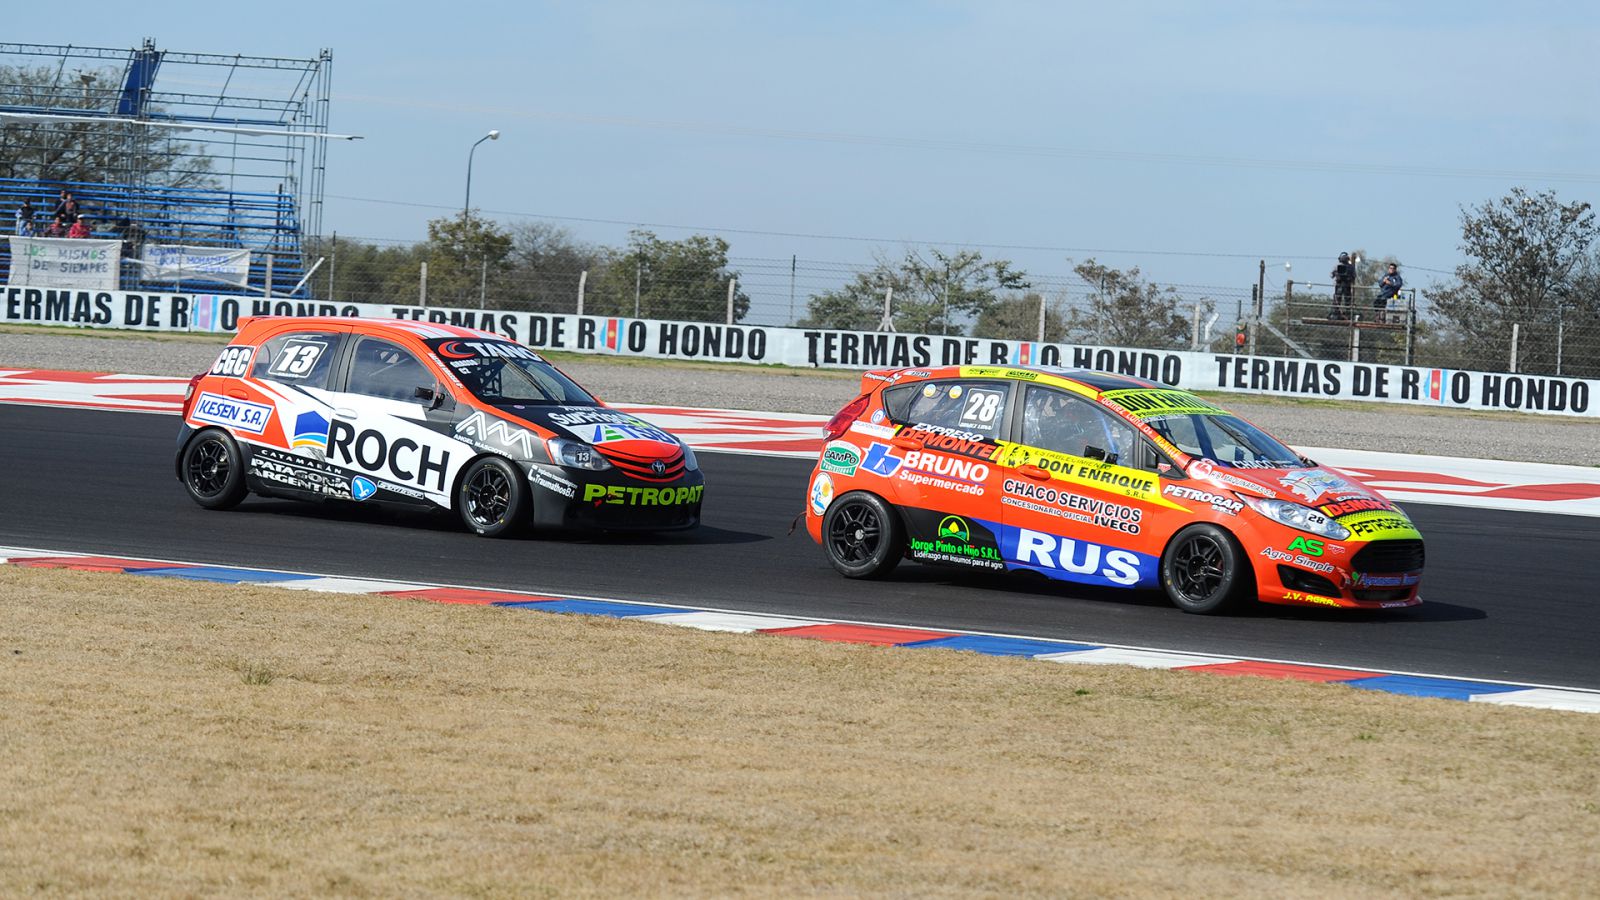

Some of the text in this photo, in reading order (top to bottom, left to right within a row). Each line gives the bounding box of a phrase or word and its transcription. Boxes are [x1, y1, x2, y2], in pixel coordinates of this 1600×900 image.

[32, 260, 108, 273] DE SIEMPRE
[58, 247, 107, 260] MISMOS
[0, 288, 112, 326] ERMAS
[124, 294, 161, 327] DE
[529, 315, 566, 348] DE
[659, 323, 767, 361] HONDO
[212, 348, 252, 376] CGC
[276, 345, 320, 374] 13
[804, 331, 931, 367] TERMAS
[1073, 347, 1182, 387] HONDO
[1215, 356, 1341, 396] TERMAS
[1352, 366, 1389, 399] DE
[1482, 375, 1590, 414] HONDO
[198, 399, 262, 426] KESEN S.A.
[962, 393, 999, 422] 28
[453, 434, 474, 446] ANGEL
[899, 427, 995, 459] DEMONTE
[911, 422, 984, 442] EXPRESO
[325, 418, 451, 492] ROCH
[576, 452, 590, 462] 13
[824, 450, 857, 465] CAMPO
[902, 450, 990, 483] BRUNO
[247, 467, 352, 499] ARGENTINA
[250, 457, 351, 491] PATAGONIA
[899, 470, 985, 496] Supermercado
[1038, 457, 1074, 475] DON
[1078, 467, 1153, 492] ENRIQUE
[583, 483, 704, 506] PETROPAT
[1003, 480, 1142, 524] CHACO SERVICIOS
[1163, 483, 1245, 513] PETROGAR
[1001, 496, 1140, 536] CONCESIONARIO OFICIAL IVECO
[1307, 513, 1325, 525] 28
[910, 538, 1002, 561] Jorge Pinto e Hijo S.R.L.
[1016, 528, 1141, 586] RUS
[1287, 535, 1325, 557] AS
[914, 550, 942, 561] Liderazgo
[972, 559, 985, 567] para
[990, 562, 1004, 571] agro
[1261, 547, 1336, 574] Agro Simple
[1282, 591, 1303, 601] J.V.
